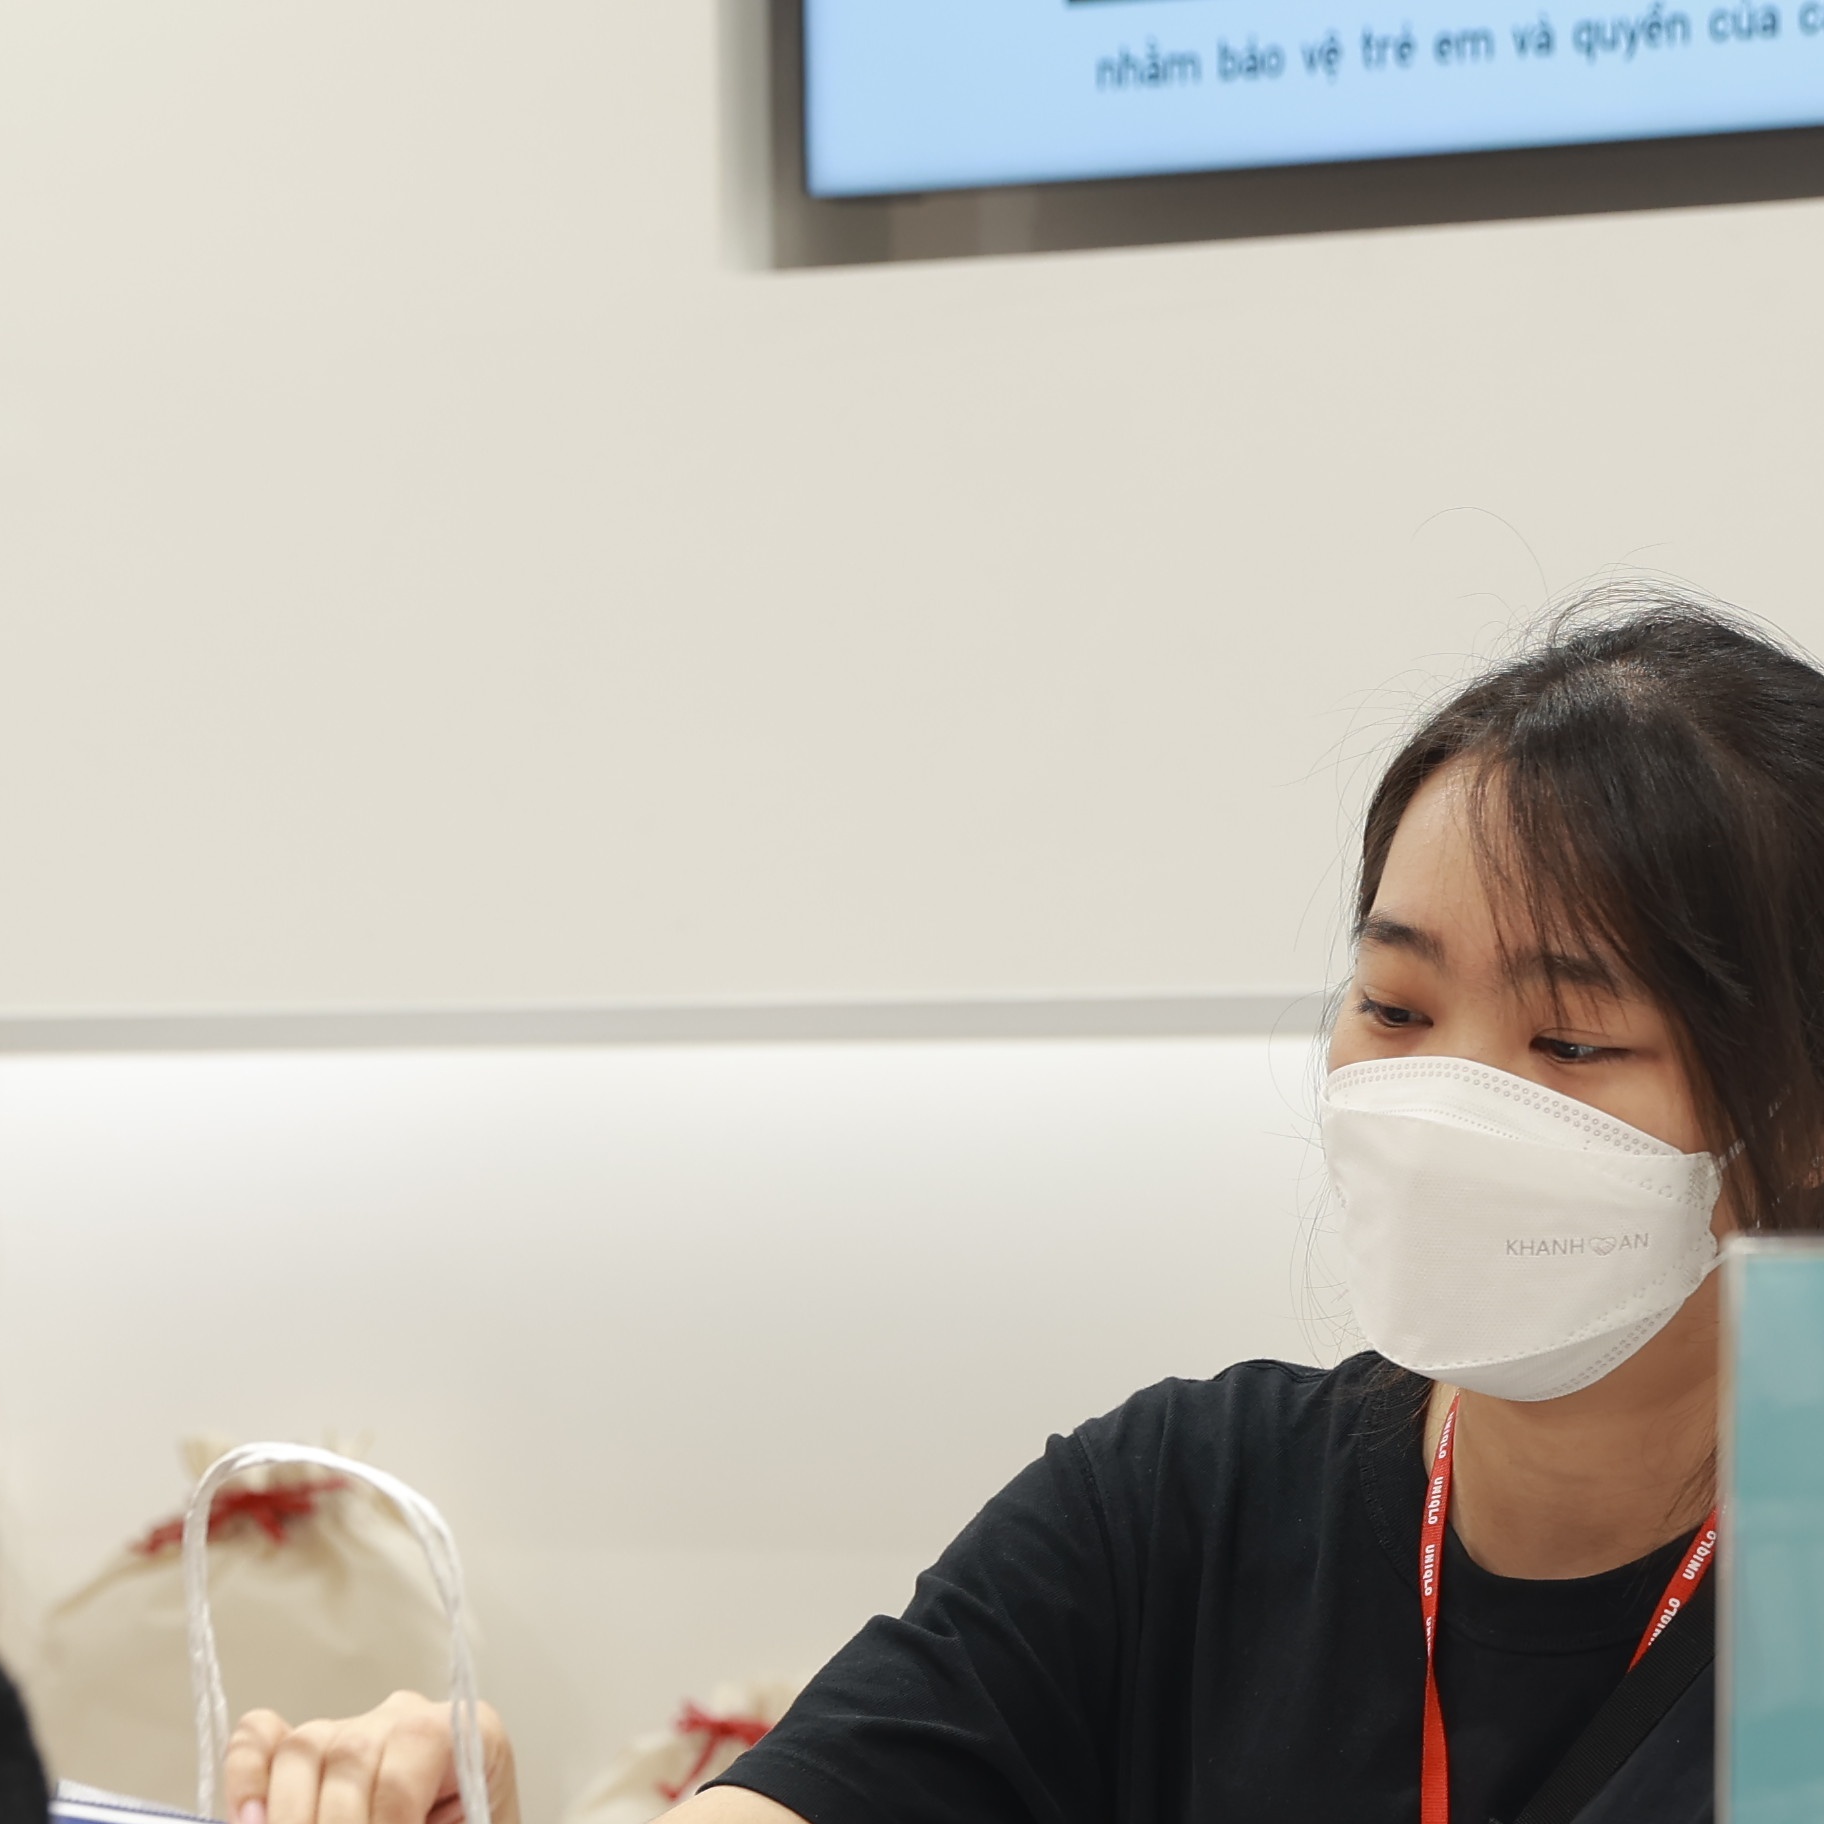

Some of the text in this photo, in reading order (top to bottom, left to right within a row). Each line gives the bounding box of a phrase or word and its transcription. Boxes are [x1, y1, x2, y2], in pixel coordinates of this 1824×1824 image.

[1432, 28, 1495, 66] em
[1506, 1233, 1649, 1256] KHANH AN
[1428, 1476, 1444, 1525] UNIQLO
[1423, 1544, 1435, 1596] UNIQLO
[1682, 1530, 1717, 1580] UNIQLO
[1648, 1597, 1681, 1646] NIQLO
